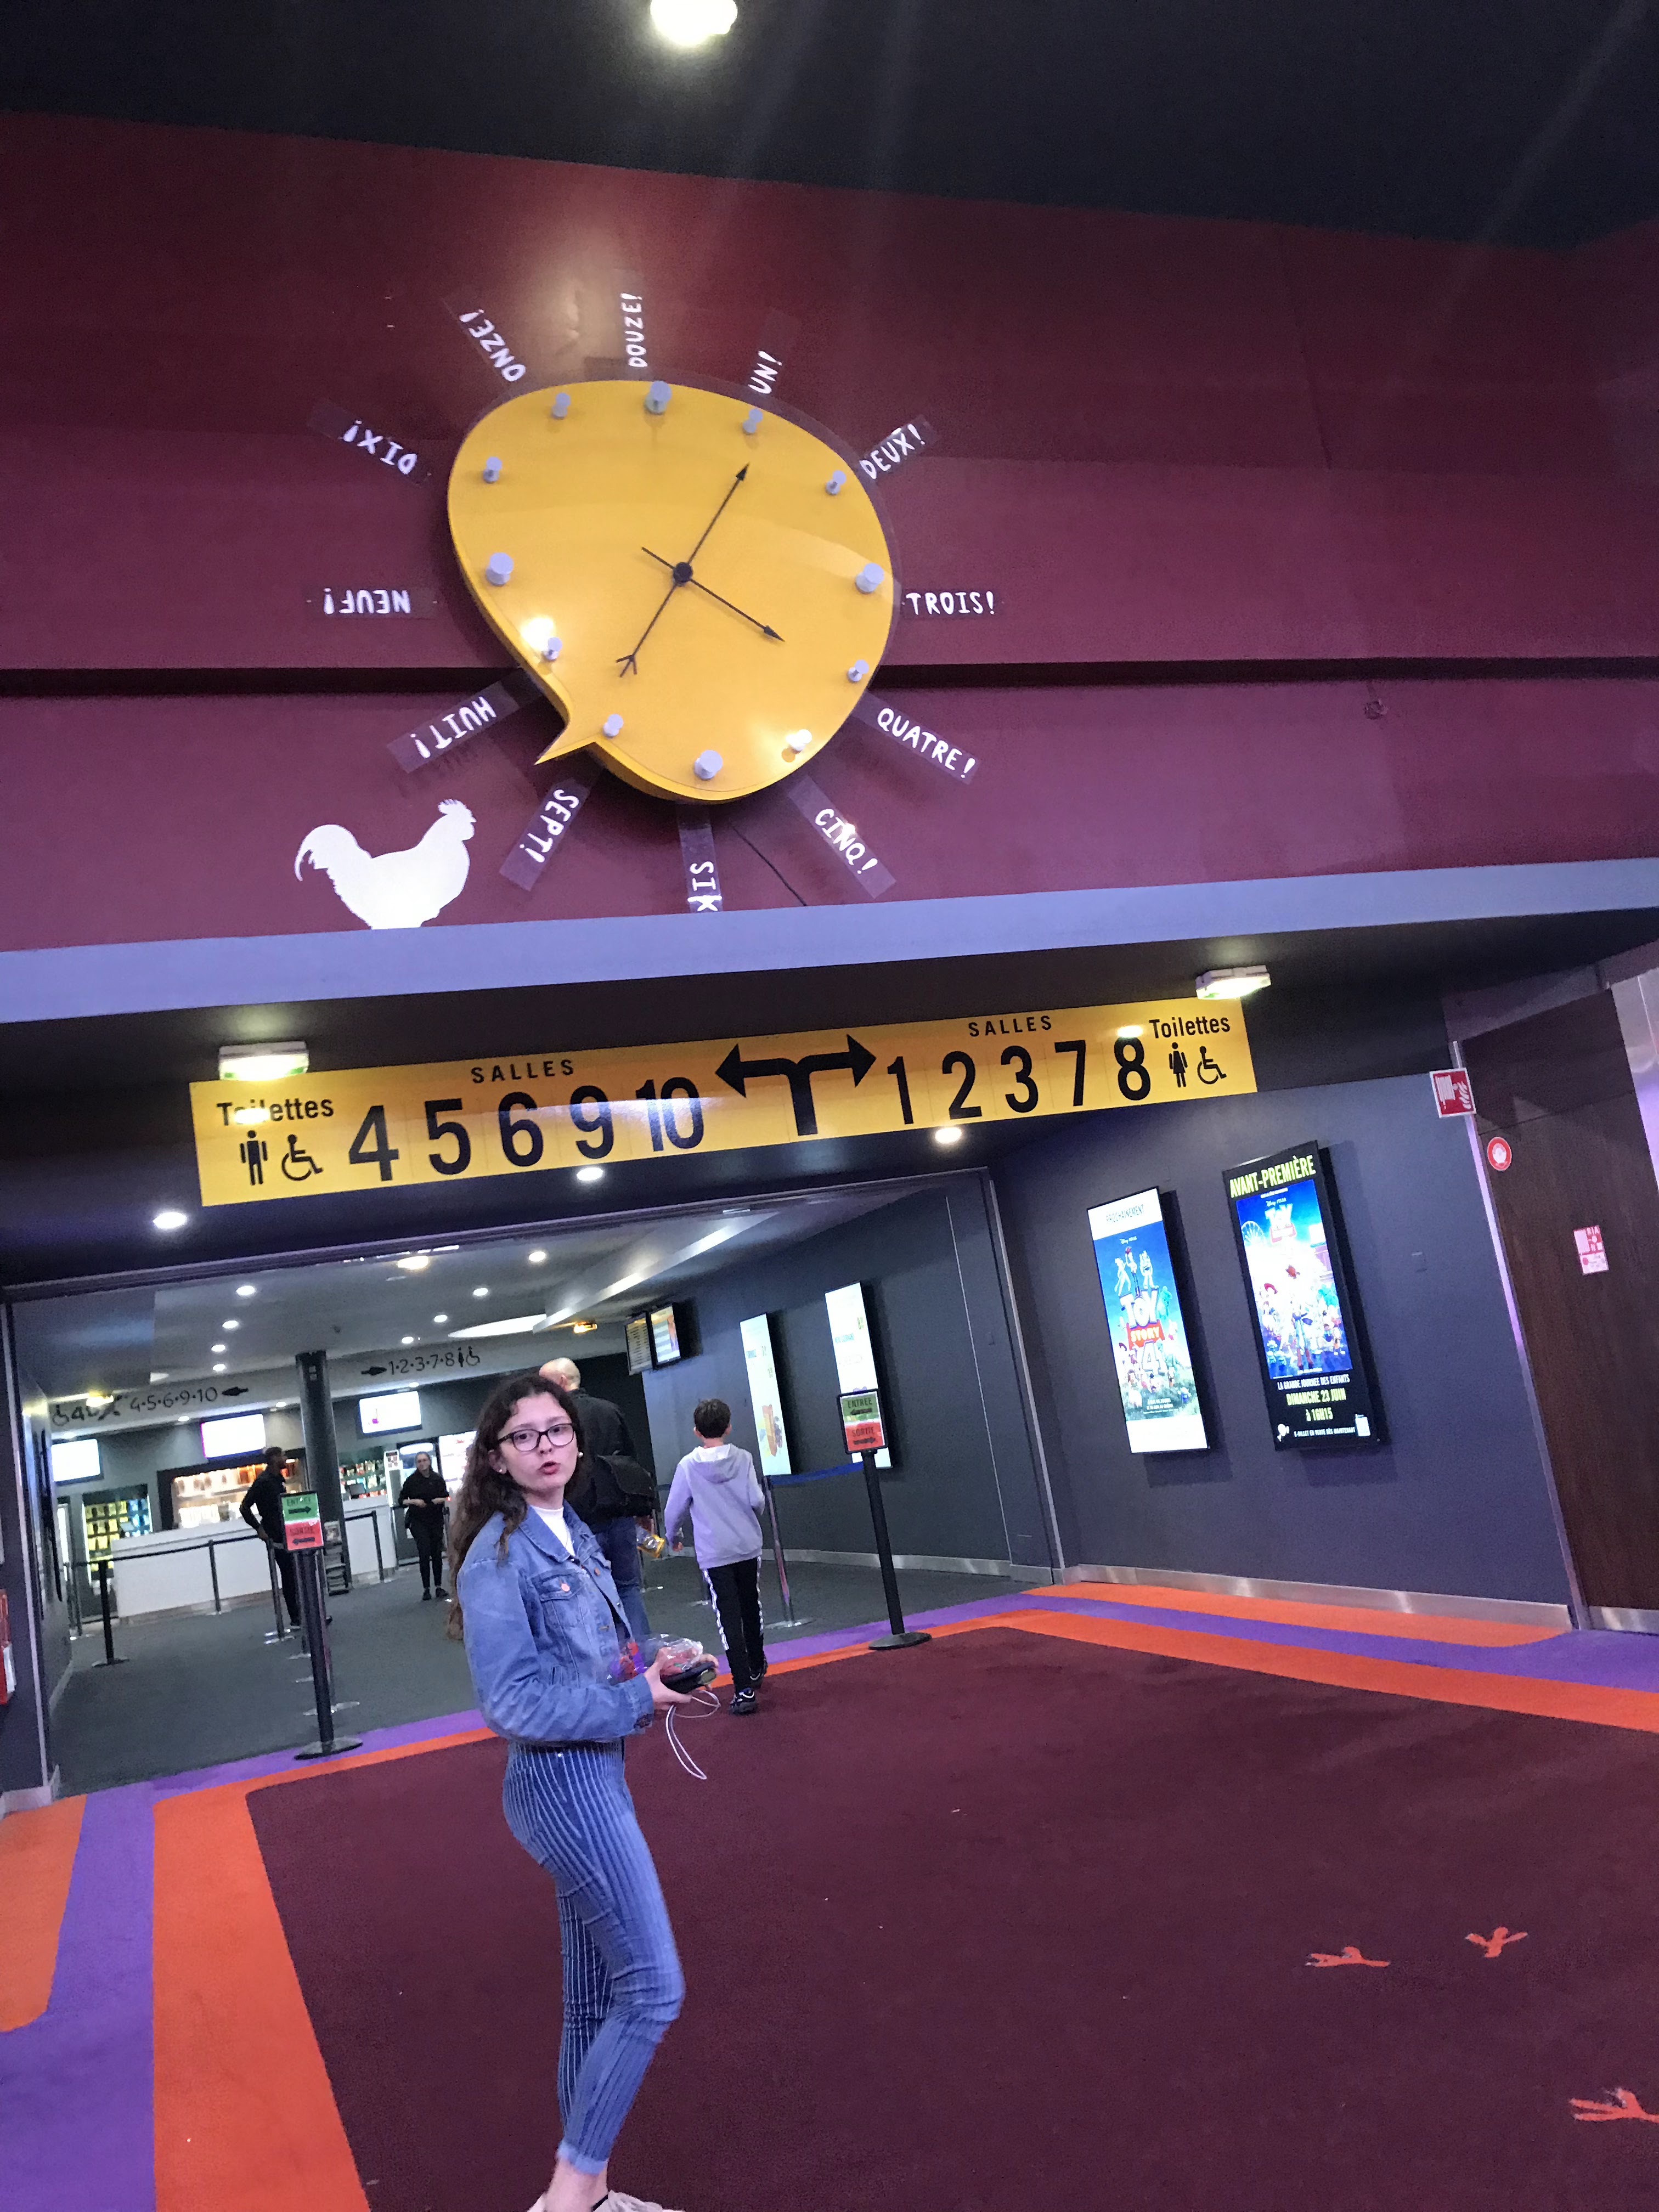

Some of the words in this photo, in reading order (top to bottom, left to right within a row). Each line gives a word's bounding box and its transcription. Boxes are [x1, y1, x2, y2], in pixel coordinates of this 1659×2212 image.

[459, 309, 526, 381] ONZE!
[620, 292, 647, 368] DOUZE!
[748, 351, 783, 394] UN!
[343, 420, 417, 475] DIX!
[859, 424, 926, 479] DEUX!
[324, 588, 411, 614] NEUF!
[906, 591, 995, 615] TROIS!
[410, 696, 497, 759] HUIT!
[877, 708, 975, 778] QUATRE!
[519, 789, 580, 864] SEPT!
[815, 809, 878, 874] CINQ!
[968, 1015, 1052, 1037] SALLES
[1149, 1017, 1231, 1040] Toilettes
[471, 1059, 574, 1084] SALLES
[887, 1056, 914, 1125] 1
[942, 1051, 982, 1120] 2
[1001, 1045, 1039, 1113] 3
[1054, 1040, 1086, 1107] 7
[1114, 1035, 1151, 1101] 8
[217, 1098, 335, 1126] Tettes
[349, 1105, 399, 1181] 4
[424, 1098, 471, 1175] 5
[498, 1091, 543, 1167] 6
[570, 1085, 614, 1159] 9
[635, 1076, 704, 1152] 10
[1229, 1154, 1316, 1198] AVANT-PREMIÈRE
[1130, 1327, 1160, 1342] STORY
[1286, 1390, 1321, 1406] DIMANCHE
